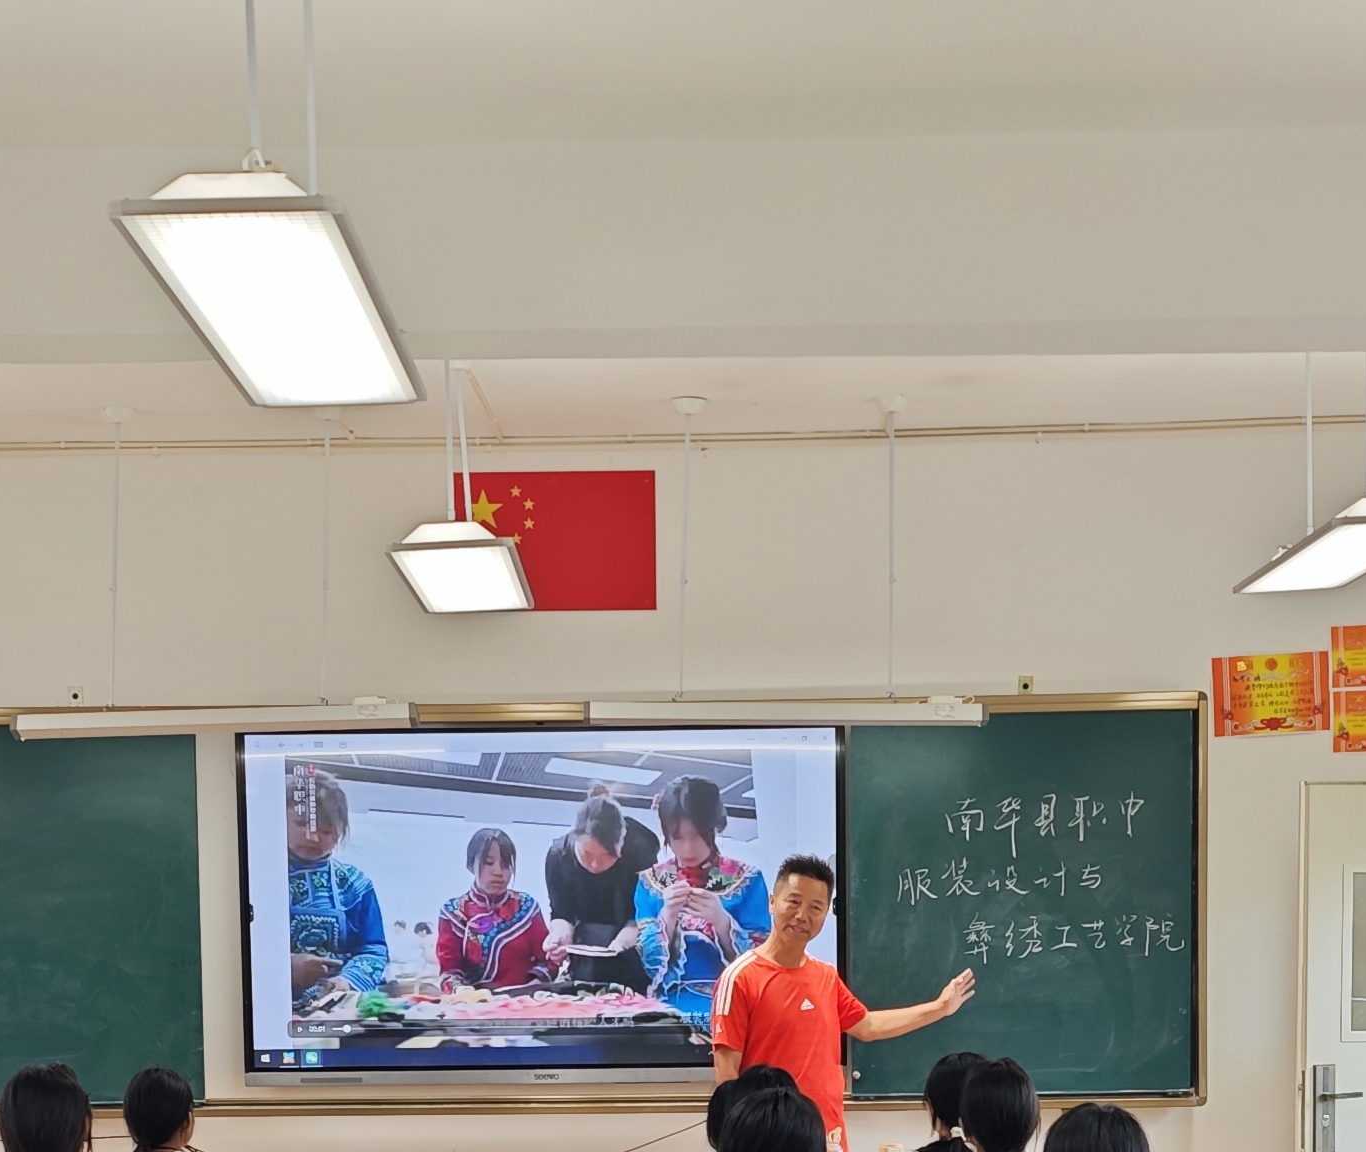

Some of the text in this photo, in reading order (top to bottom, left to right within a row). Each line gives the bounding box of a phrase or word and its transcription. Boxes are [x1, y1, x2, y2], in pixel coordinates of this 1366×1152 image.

[945, 791, 1144, 858] 南华县职中
[897, 857, 1102, 905] 服装设计与
[963, 912, 1185, 964] 彝绣工艺学院
